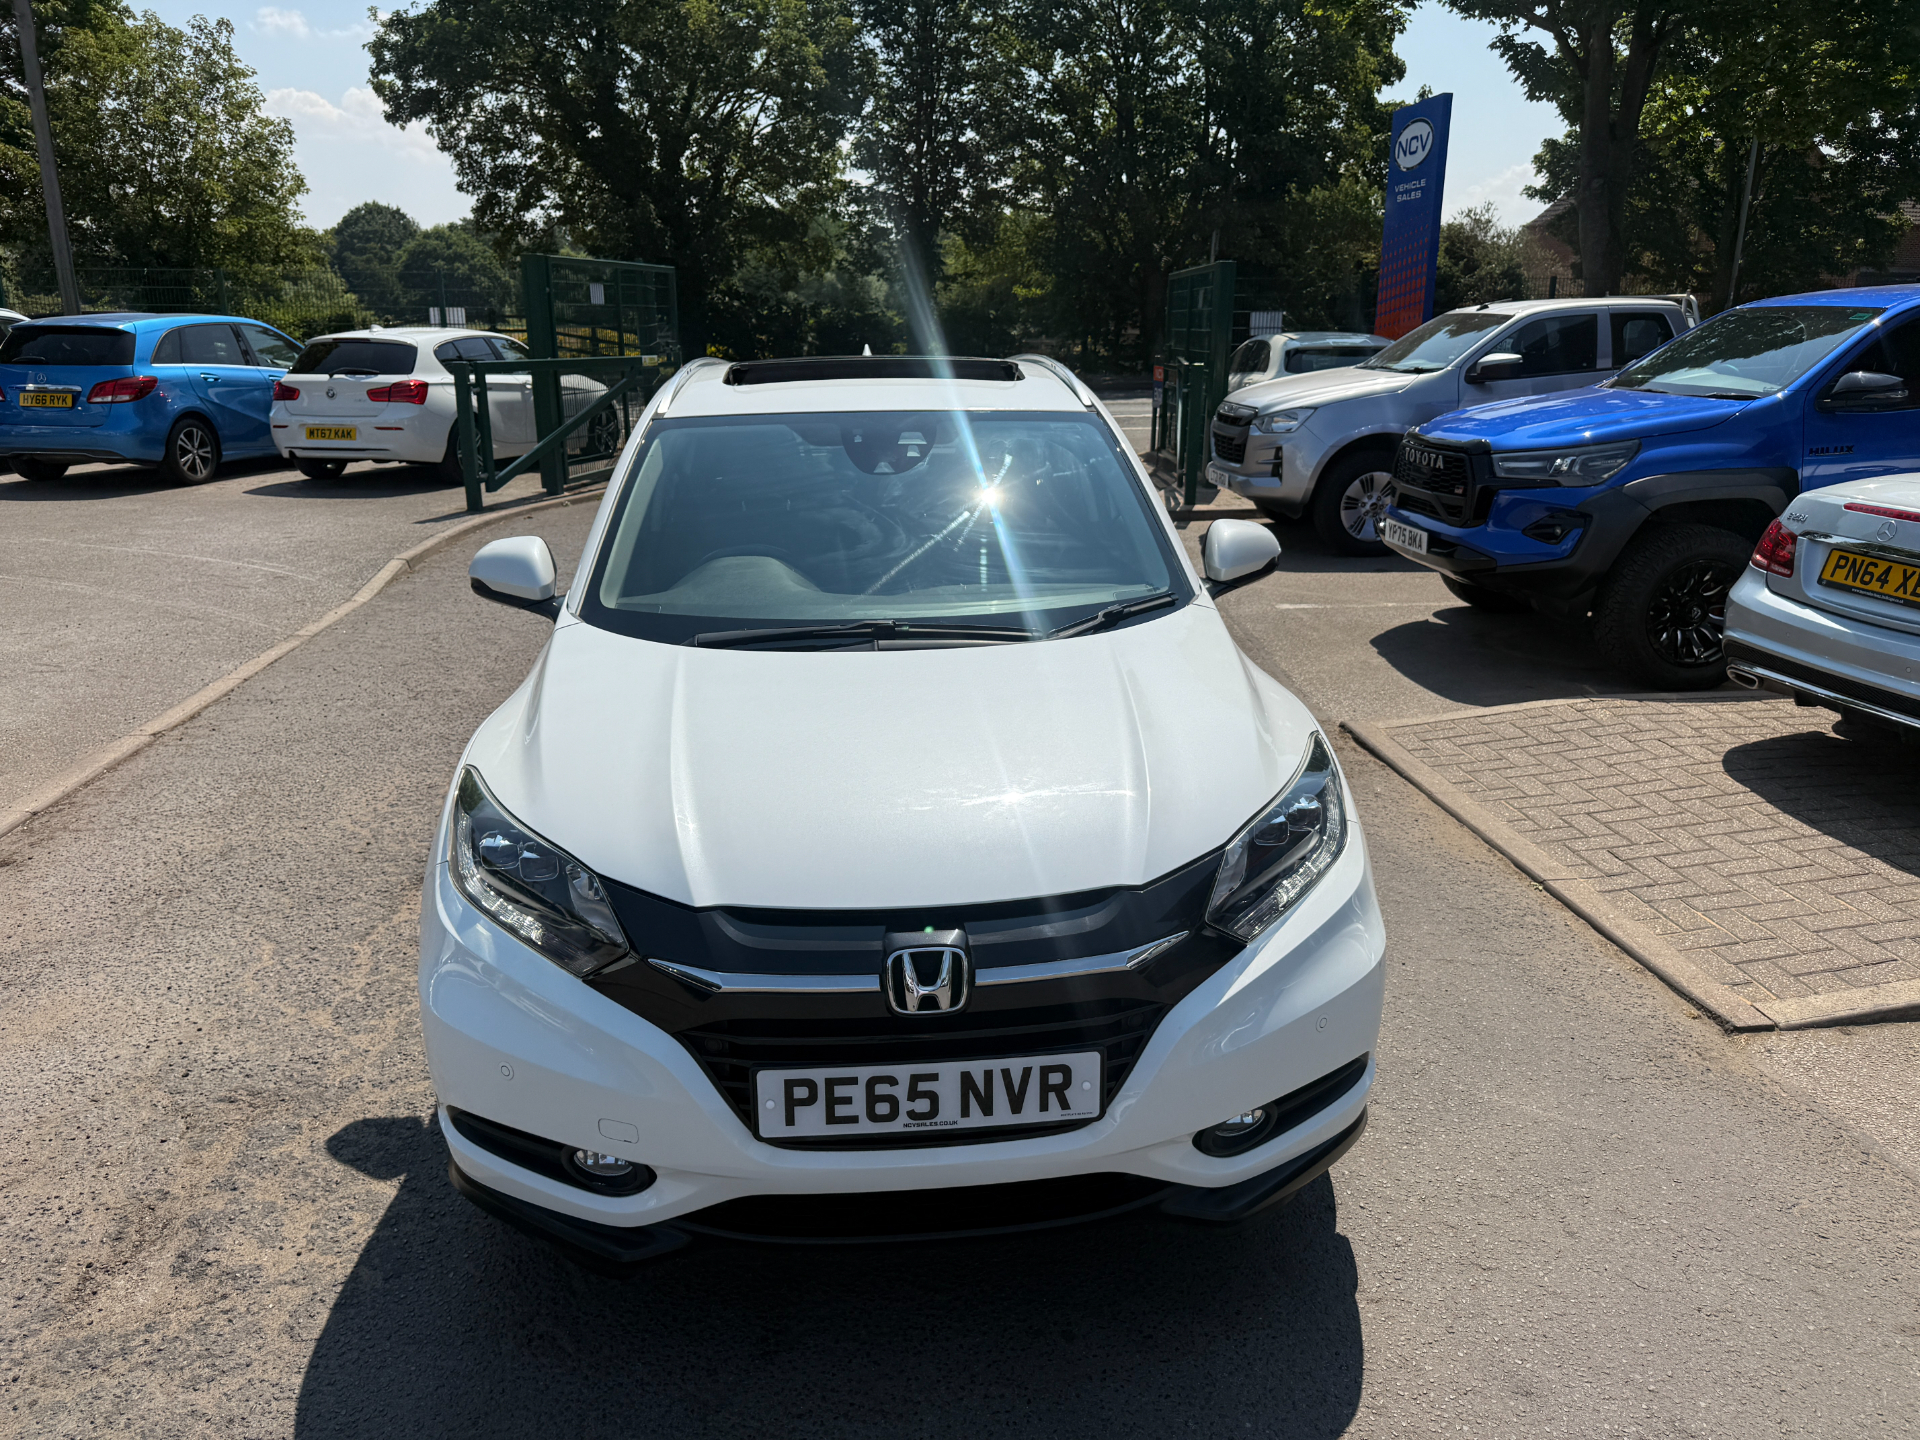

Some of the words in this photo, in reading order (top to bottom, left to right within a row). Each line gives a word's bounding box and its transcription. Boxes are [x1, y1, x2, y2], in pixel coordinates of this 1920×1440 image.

[1397, 131, 1430, 159] NCV
[1395, 179, 1426, 192] VEHICLE
[1397, 190, 1421, 202] SALES
[23, 395, 47, 405] HY66
[50, 395, 68, 405] RYK
[309, 428, 333, 439] MT67
[334, 429, 353, 439] KAK
[1405, 447, 1444, 469] TOYOTA
[1808, 445, 1855, 456] HILUX
[1388, 522, 1407, 544] YP75
[1407, 530, 1422, 551] BKA
[1830, 554, 1893, 590] PN64
[783, 1072, 940, 1127] PE65
[960, 1063, 1073, 1119] NVR
